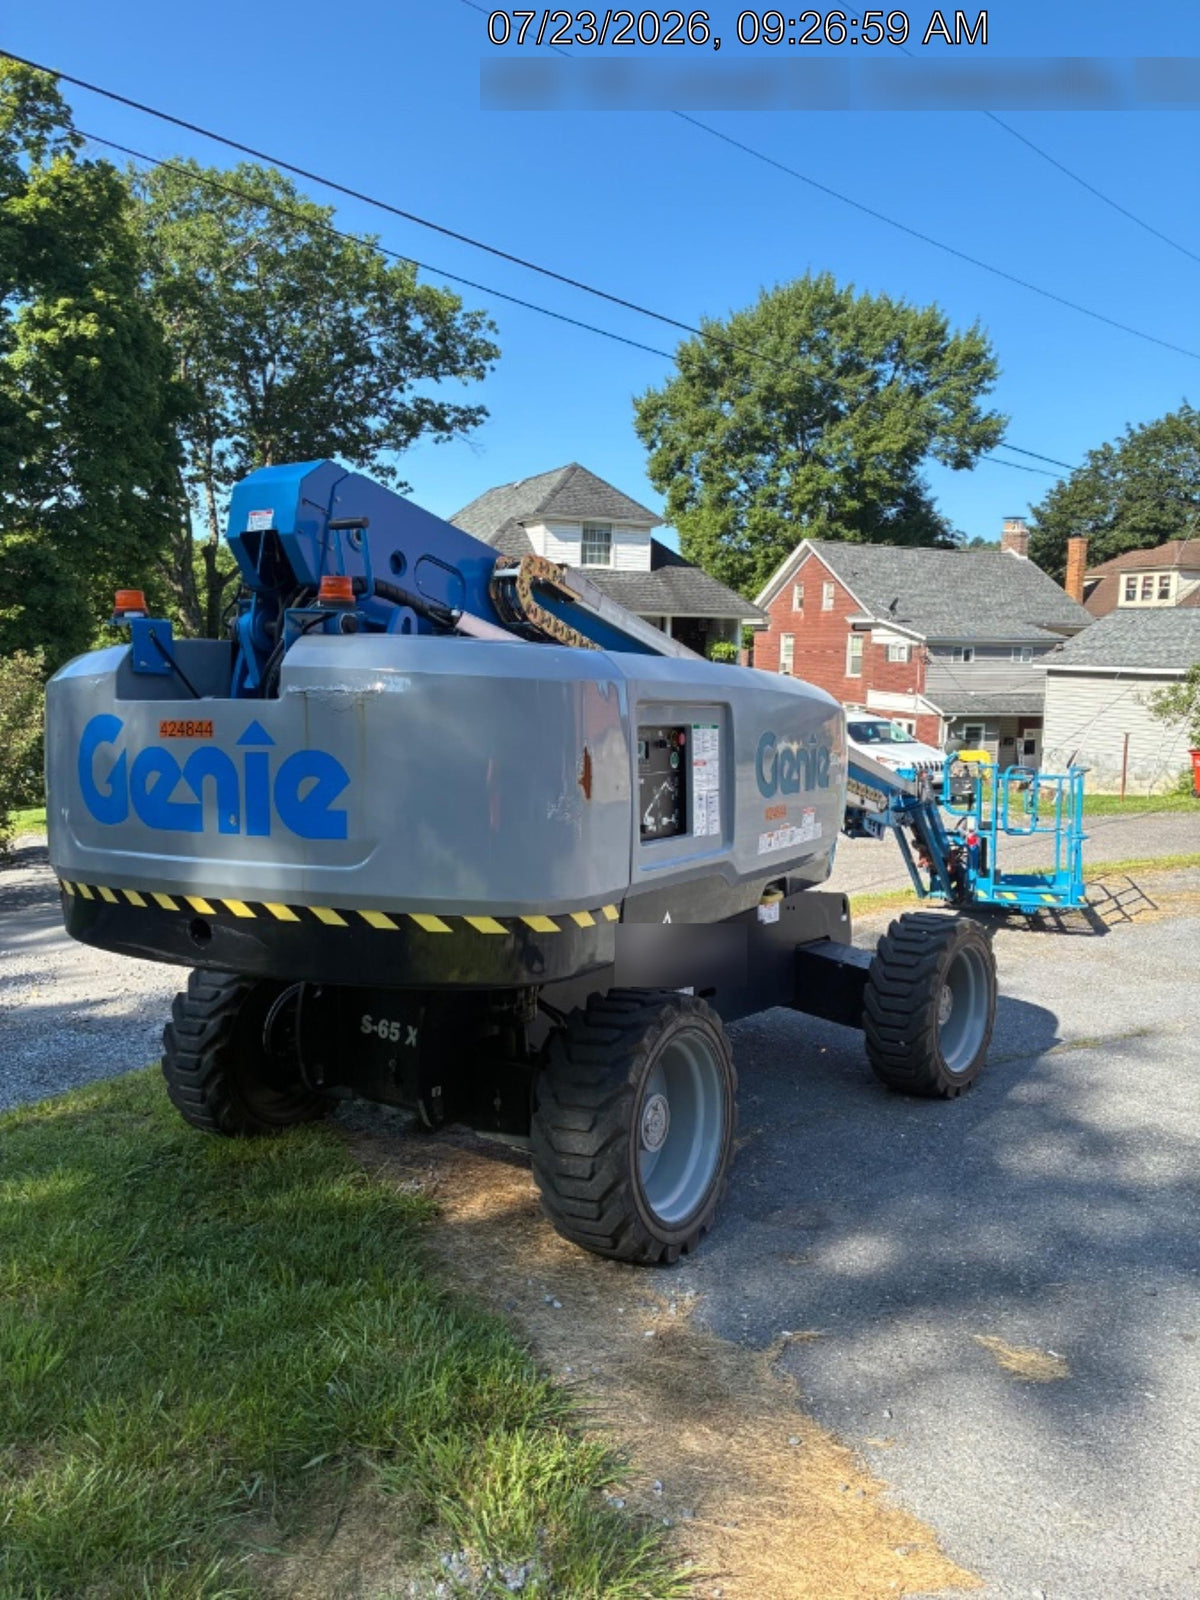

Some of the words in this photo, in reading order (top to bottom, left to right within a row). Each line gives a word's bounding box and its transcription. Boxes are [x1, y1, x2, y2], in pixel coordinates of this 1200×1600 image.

[160, 720, 213, 737] 424844
[78, 713, 350, 840] Genie
[755, 730, 830, 799] Genie
[360, 1014, 401, 1042] S-65
[404, 1024, 418, 1048] X
